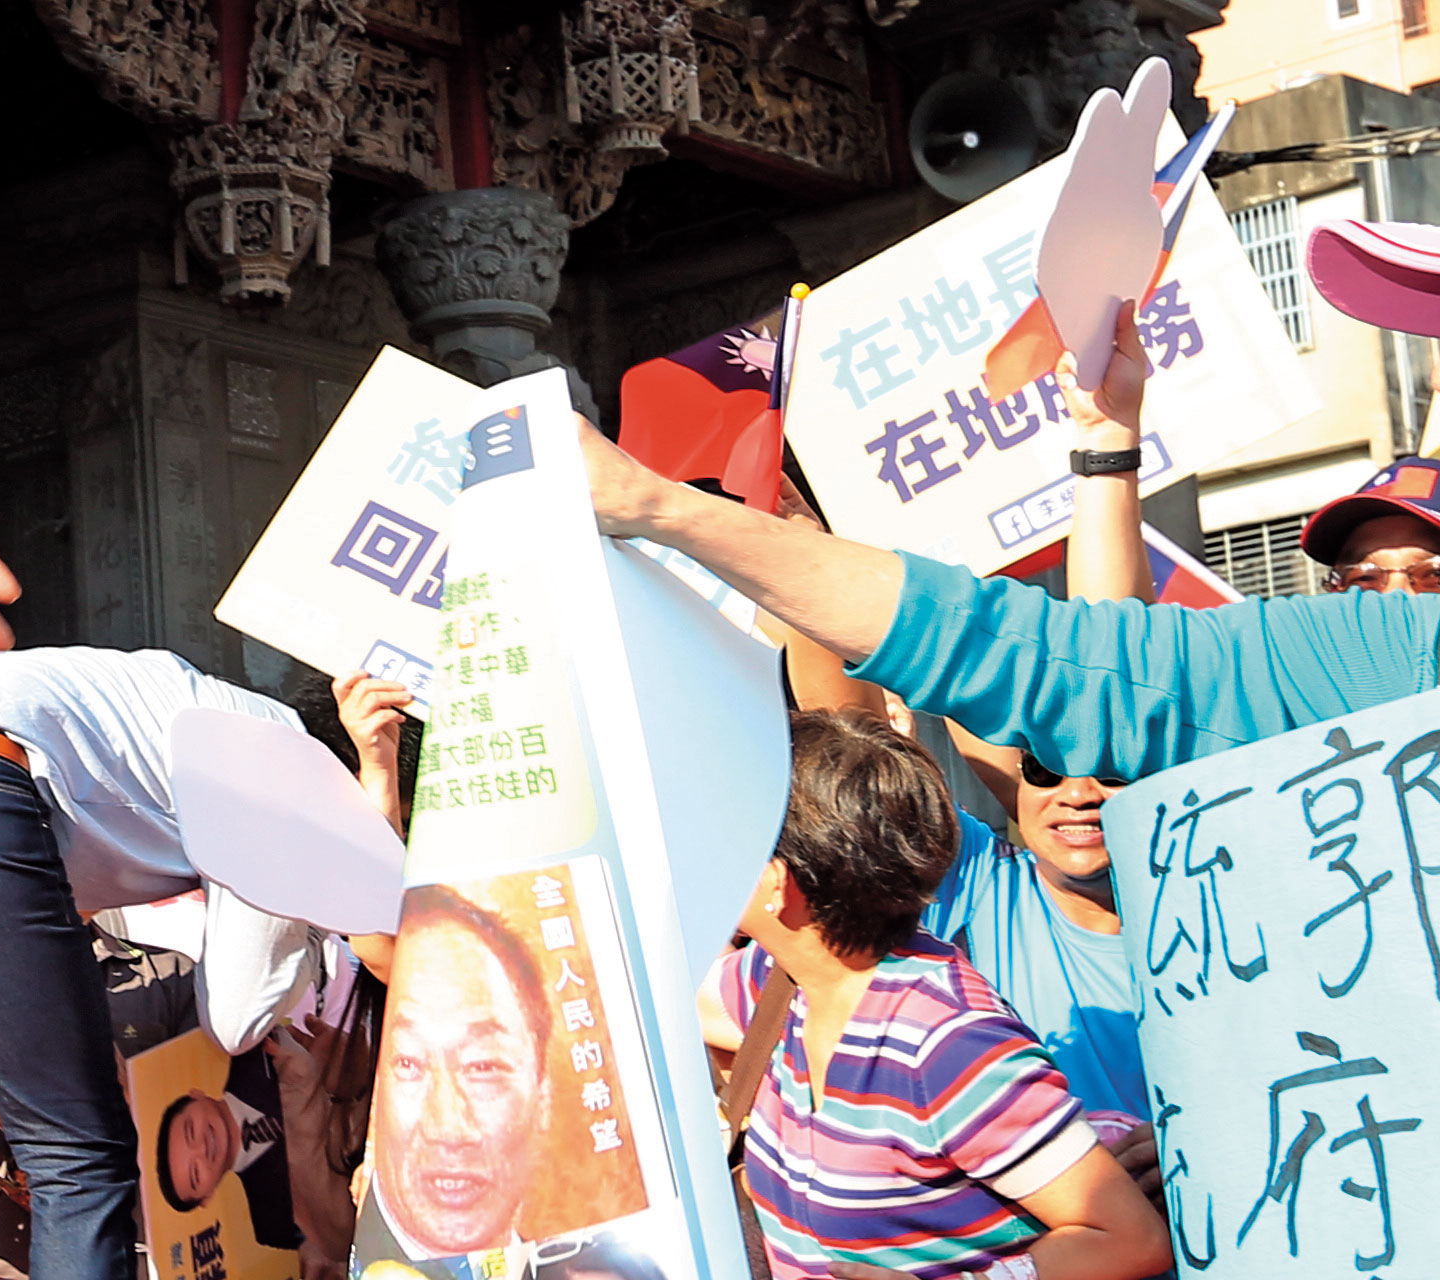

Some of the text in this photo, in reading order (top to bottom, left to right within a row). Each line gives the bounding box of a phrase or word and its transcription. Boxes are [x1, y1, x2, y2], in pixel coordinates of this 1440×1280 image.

[865, 279, 1204, 504] 在地務
[330, 499, 448, 610] 回
[531, 874, 624, 1156] 全國人民的希望
